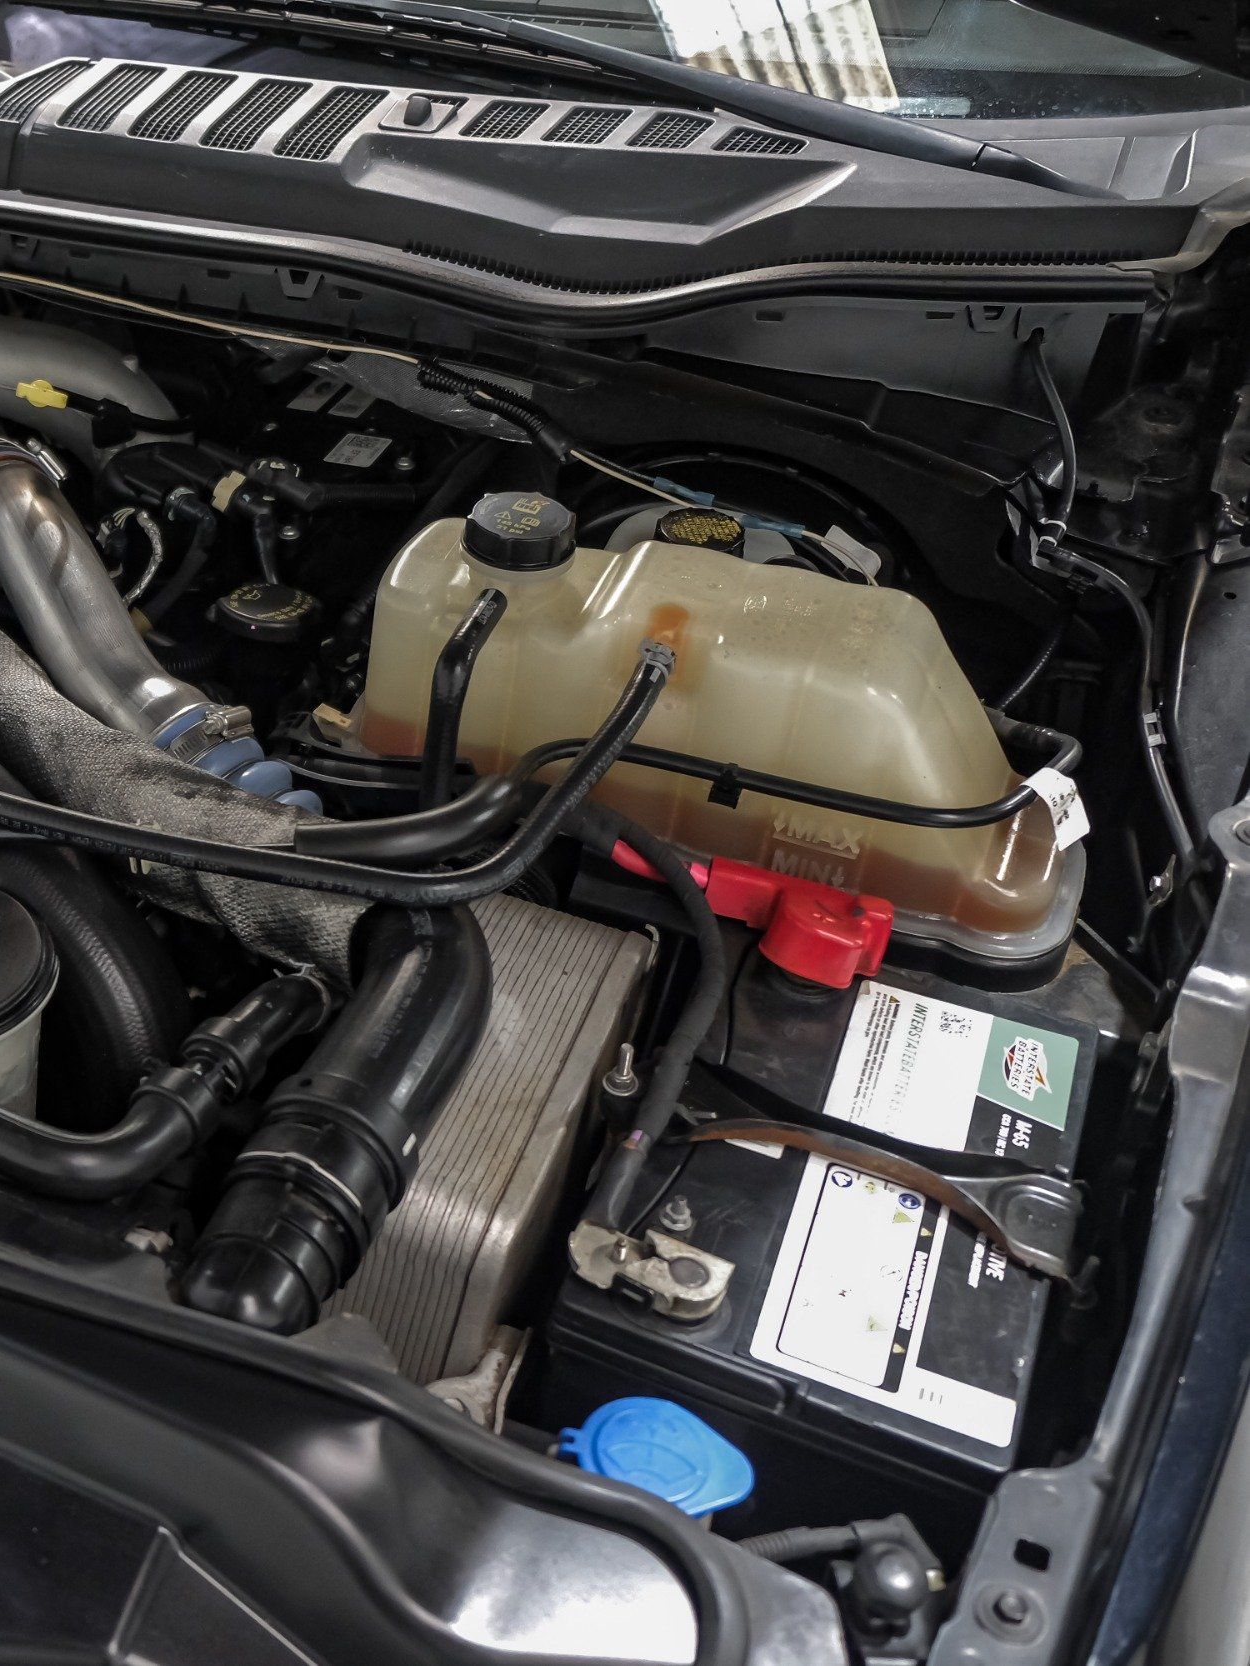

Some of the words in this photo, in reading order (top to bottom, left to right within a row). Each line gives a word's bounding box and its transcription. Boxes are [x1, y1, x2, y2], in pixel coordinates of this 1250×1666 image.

[787, 817, 862, 855] MAX
[771, 850, 831, 884] MIN
[1010, 1041, 1026, 1088] BATTERIES
[1021, 1042, 1038, 1094] INTERSTATE
